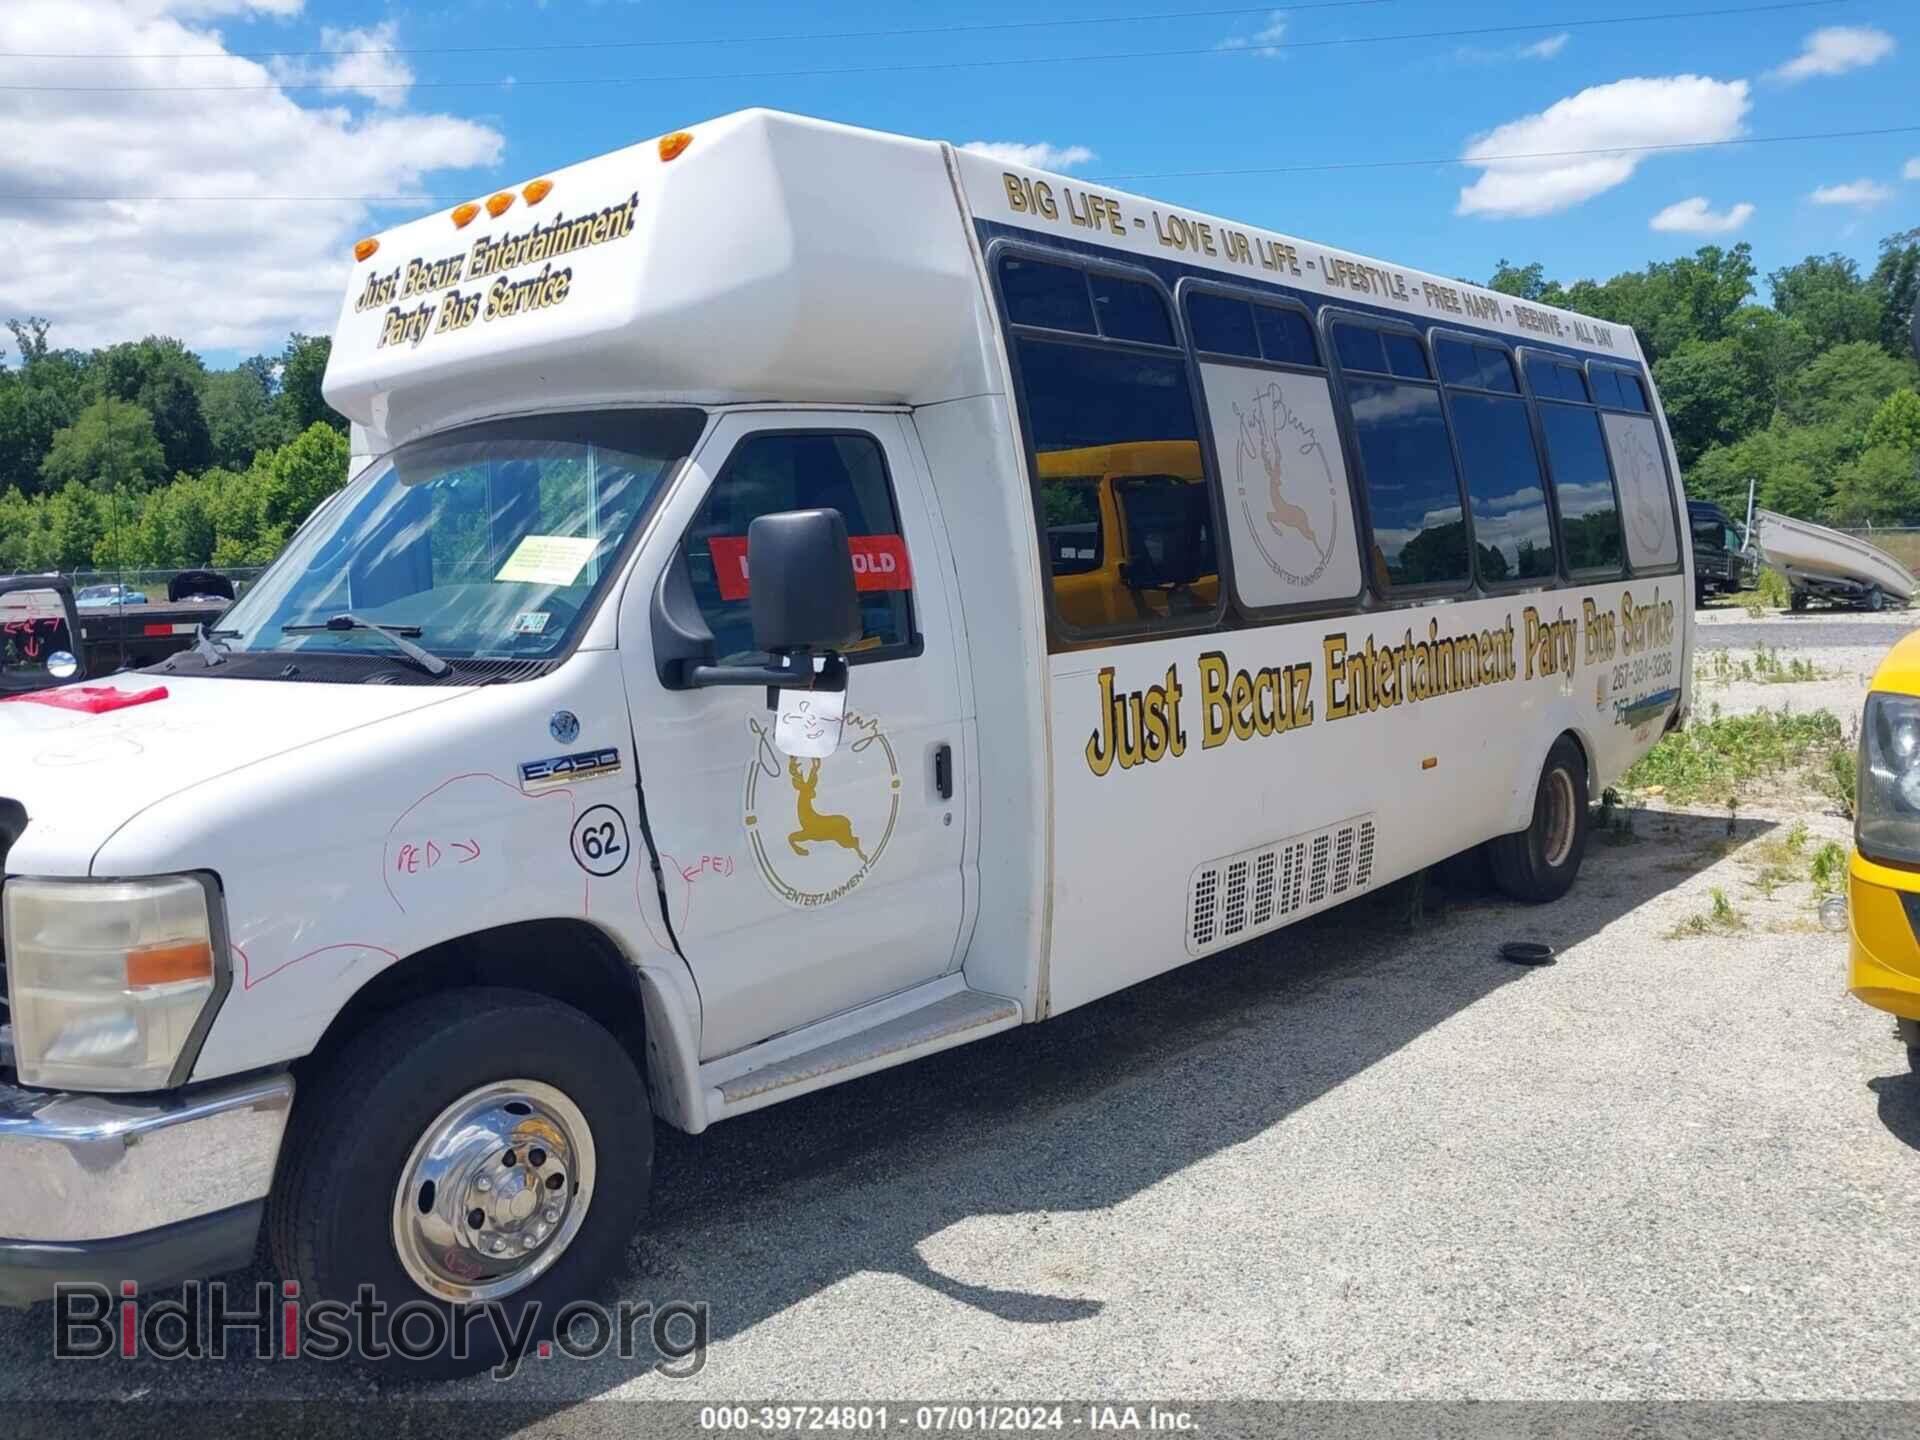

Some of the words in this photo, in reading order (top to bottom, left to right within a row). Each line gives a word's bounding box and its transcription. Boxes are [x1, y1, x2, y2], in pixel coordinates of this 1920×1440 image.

[355, 266, 402, 313] Just
[399, 252, 466, 300] Becuz
[464, 191, 639, 282] Entertainment
[1002, 172, 1059, 220] BIG
[1063, 188, 1127, 236] LIFE
[1152, 210, 1217, 257] LOVE
[1219, 228, 1253, 265] UR
[1255, 237, 1302, 276] LIFE
[1319, 255, 1409, 302] LIFESTYLE
[1422, 281, 1463, 314] FREE
[1513, 304, 1565, 338] BEEHIVE
[1573, 320, 1600, 345] ALL
[1598, 325, 1615, 349] DAY
[377, 300, 436, 350] Party
[435, 288, 481, 335] Bus
[483, 262, 572, 322] Service
[1086, 662, 1186, 777] Just
[1197, 650, 1314, 751] Becuz
[1322, 612, 1516, 722] Entertainment
[1522, 604, 1579, 680] Party
[1582, 597, 1617, 666] Bus
[1619, 586, 1675, 657] Service
[582, 822, 620, 859] 62
[785, 864, 871, 907] ENTERTAINMENT
